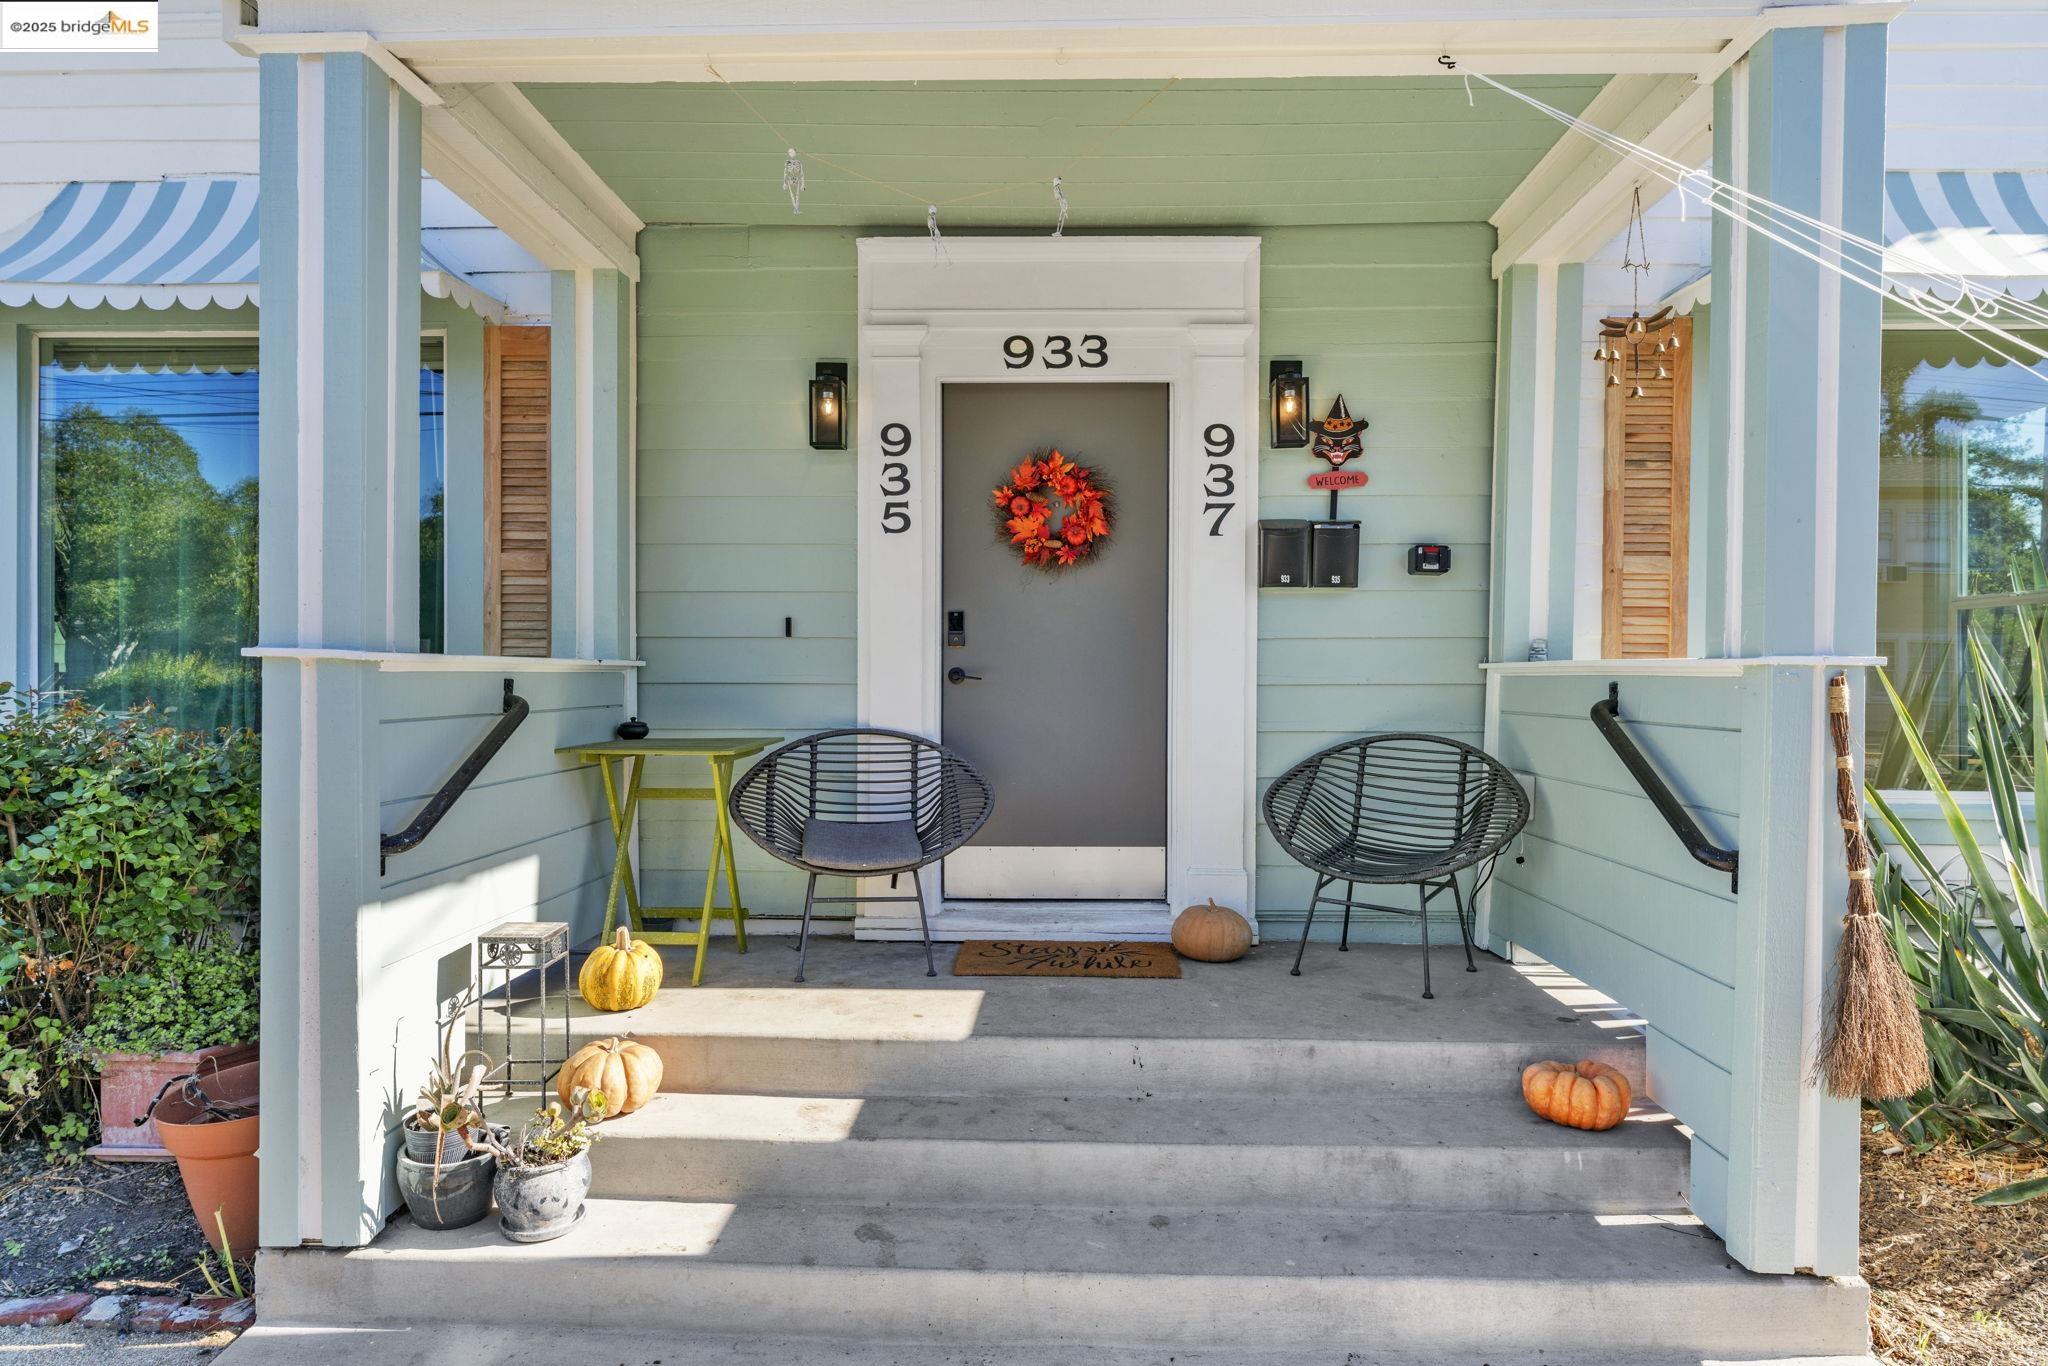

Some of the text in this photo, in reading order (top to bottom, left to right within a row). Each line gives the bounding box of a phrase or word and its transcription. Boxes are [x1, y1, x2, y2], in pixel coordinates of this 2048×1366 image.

[1002, 334, 1109, 370] 933
[880, 422, 912, 535] 935
[1202, 423, 1236, 537] 937
[1315, 475, 1361, 487] WELCOME
[1280, 574, 1291, 584] 933
[1331, 575, 1341, 584] 935
